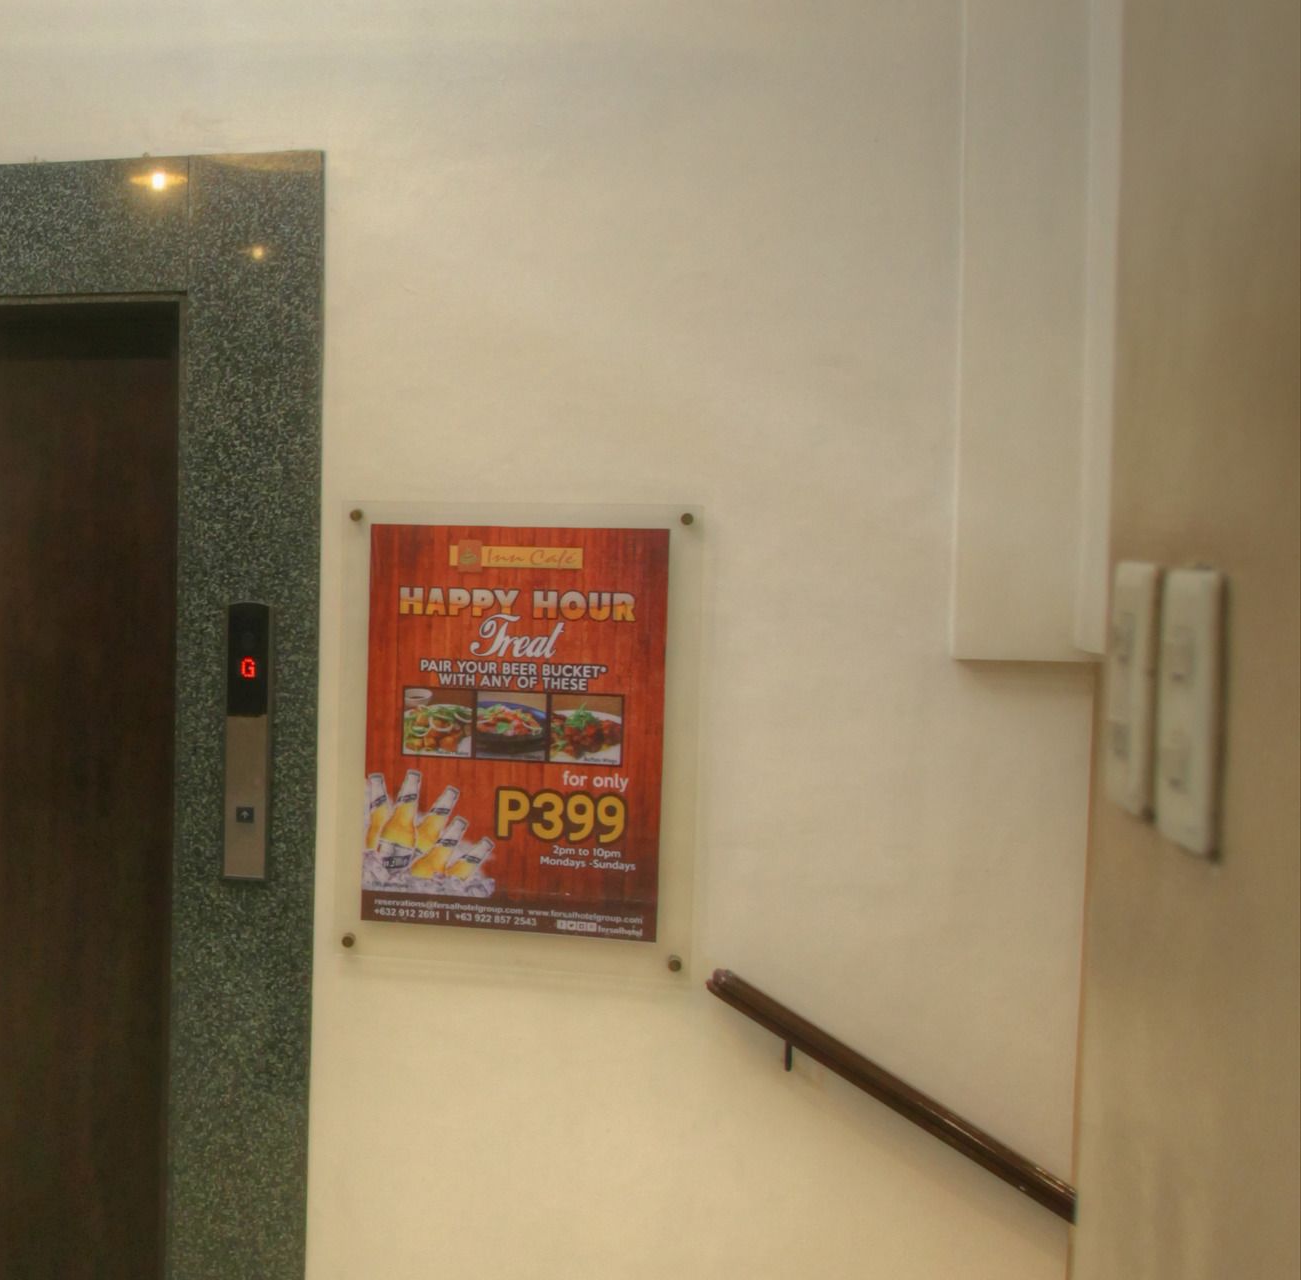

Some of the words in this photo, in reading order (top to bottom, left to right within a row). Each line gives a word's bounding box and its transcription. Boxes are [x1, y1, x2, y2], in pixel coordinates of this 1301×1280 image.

[399, 586, 520, 617] HAPPY
[532, 590, 637, 622] HOUR
[469, 613, 565, 658] Treat
[240, 657, 255, 678] G
[420, 660, 452, 673] PAIR
[457, 661, 498, 675] YOUR
[502, 663, 537, 676] BEER
[439, 673, 476, 686] WITH
[480, 675, 512, 688] ANY
[516, 676, 537, 689] OF
[543, 677, 588, 691] THESE
[562, 770, 586, 787] for
[593, 774, 628, 791] only
[497, 789, 626, 843] P399
[539, 855, 587, 869] Mondays
[552, 845, 576, 857] 2pm
[578, 847, 590, 856] to
[593, 848, 621, 860] 10pm
